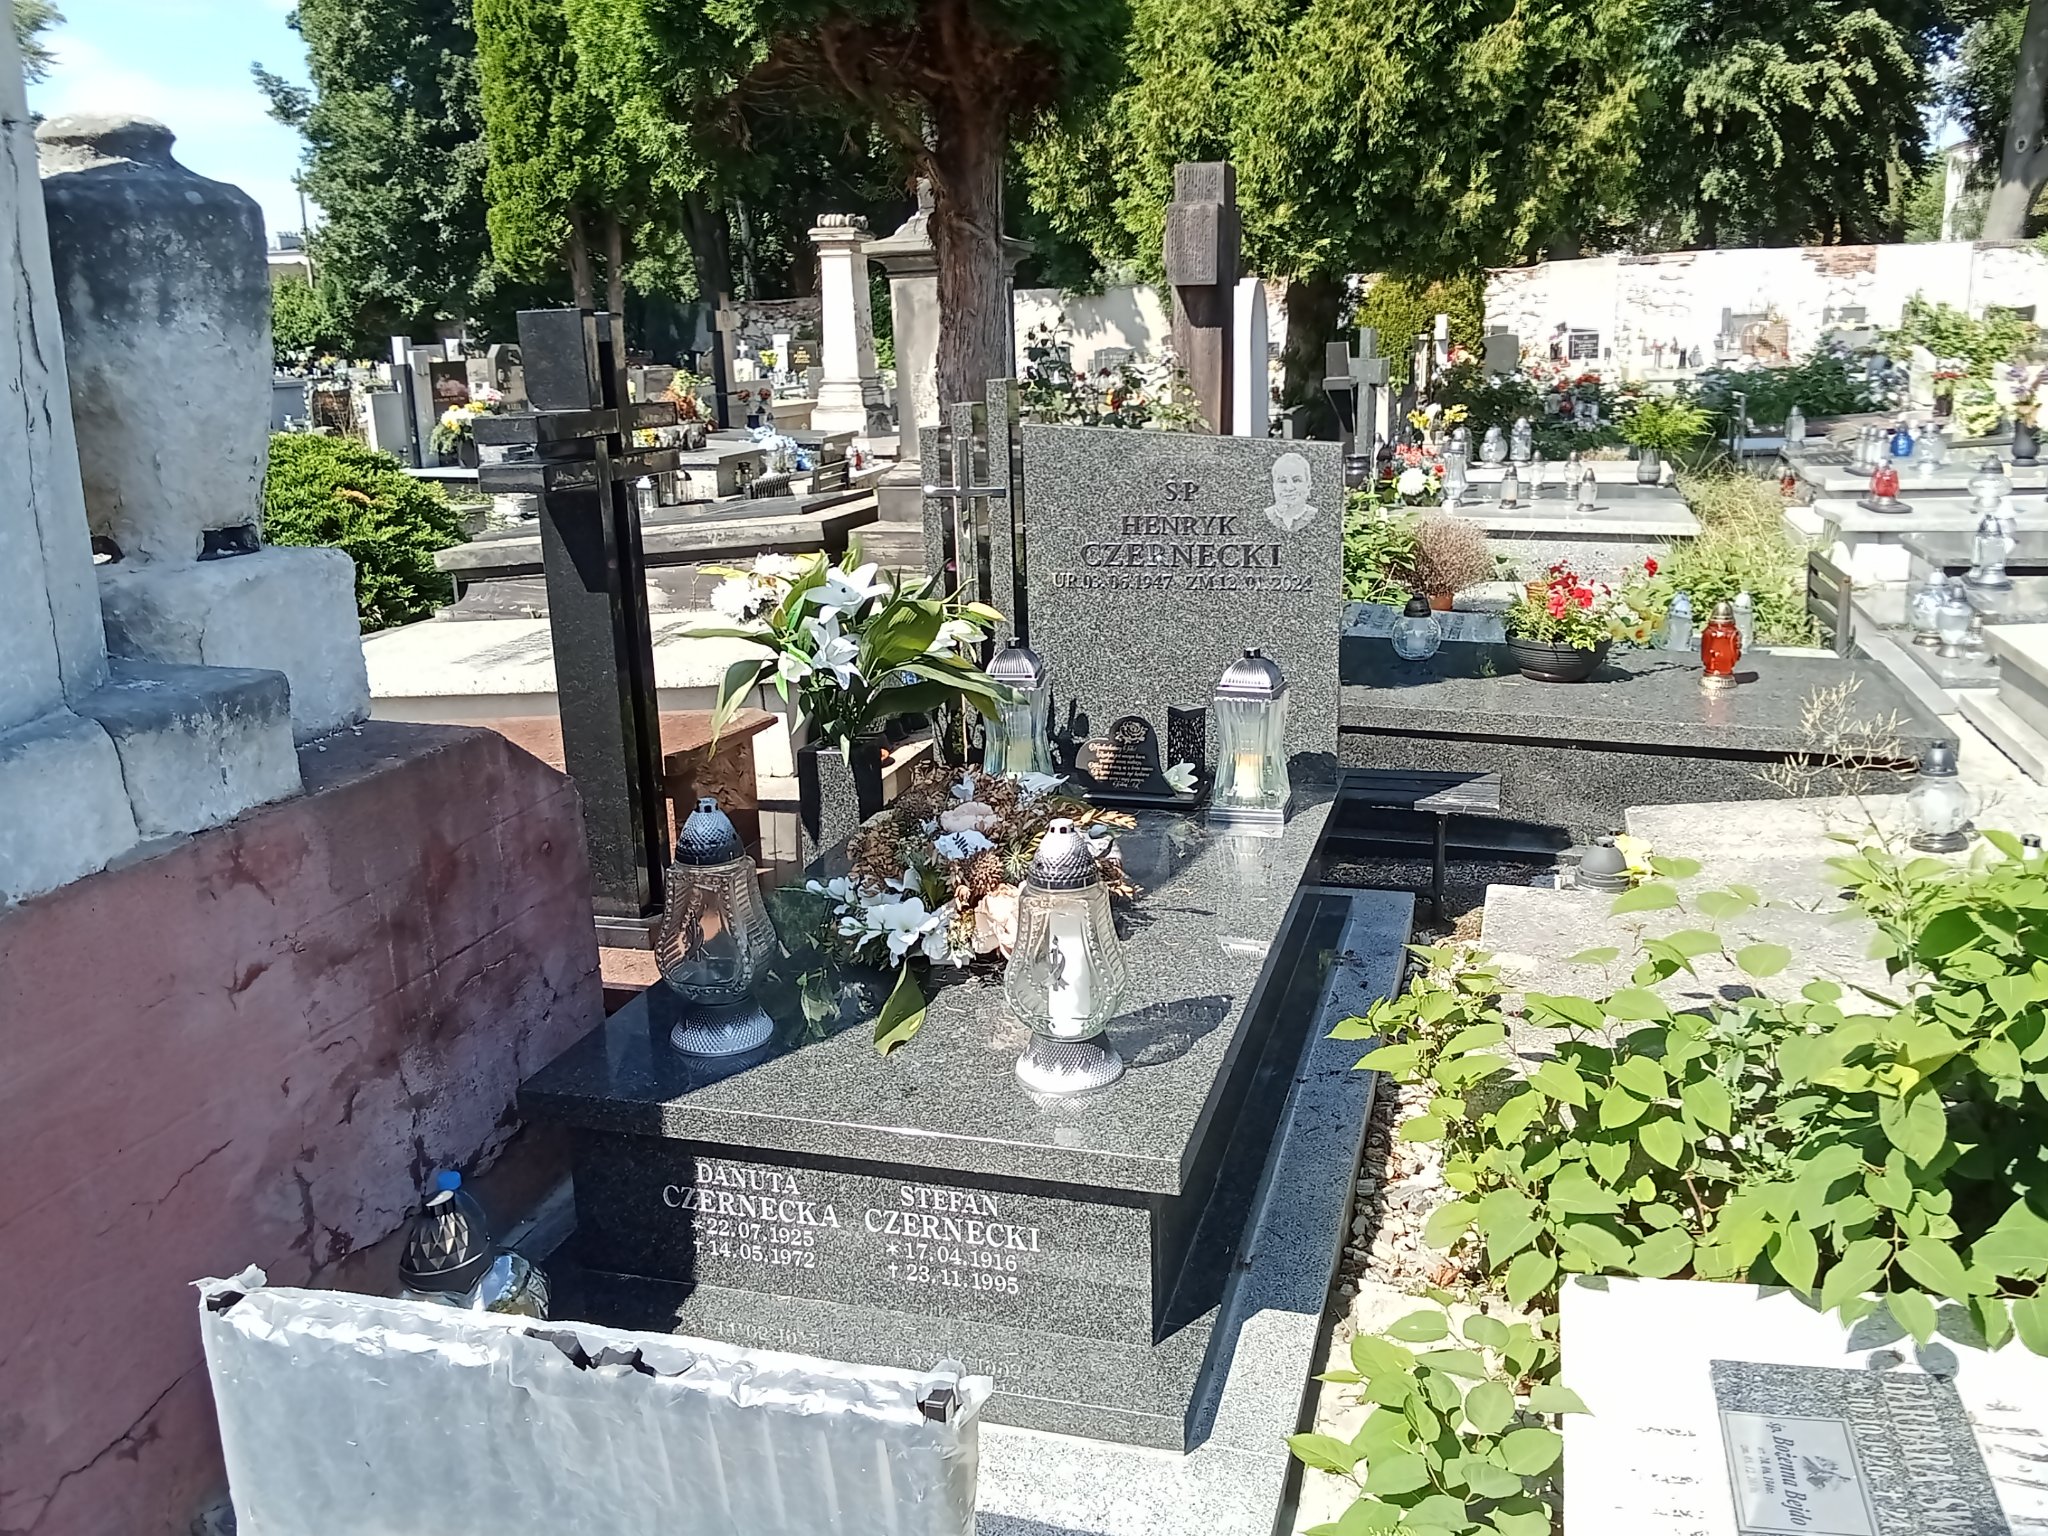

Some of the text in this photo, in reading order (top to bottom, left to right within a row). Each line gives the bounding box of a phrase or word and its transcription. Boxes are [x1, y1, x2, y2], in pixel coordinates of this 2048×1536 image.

[1121, 514, 1238, 536] HENRYK
[1081, 542, 1282, 569] CZERNECKI
[696, 1162, 800, 1195] DANUTA
[662, 1184, 841, 1228] CZERNECKA
[901, 1185, 999, 1217] STEFAN
[864, 1208, 1041, 1252] CZERNECKI
[1882, 1382, 1960, 1483] BARBARA
[1773, 1435, 1798, 1487] Bożenna
[1781, 1489, 1812, 1526] Bejdo
